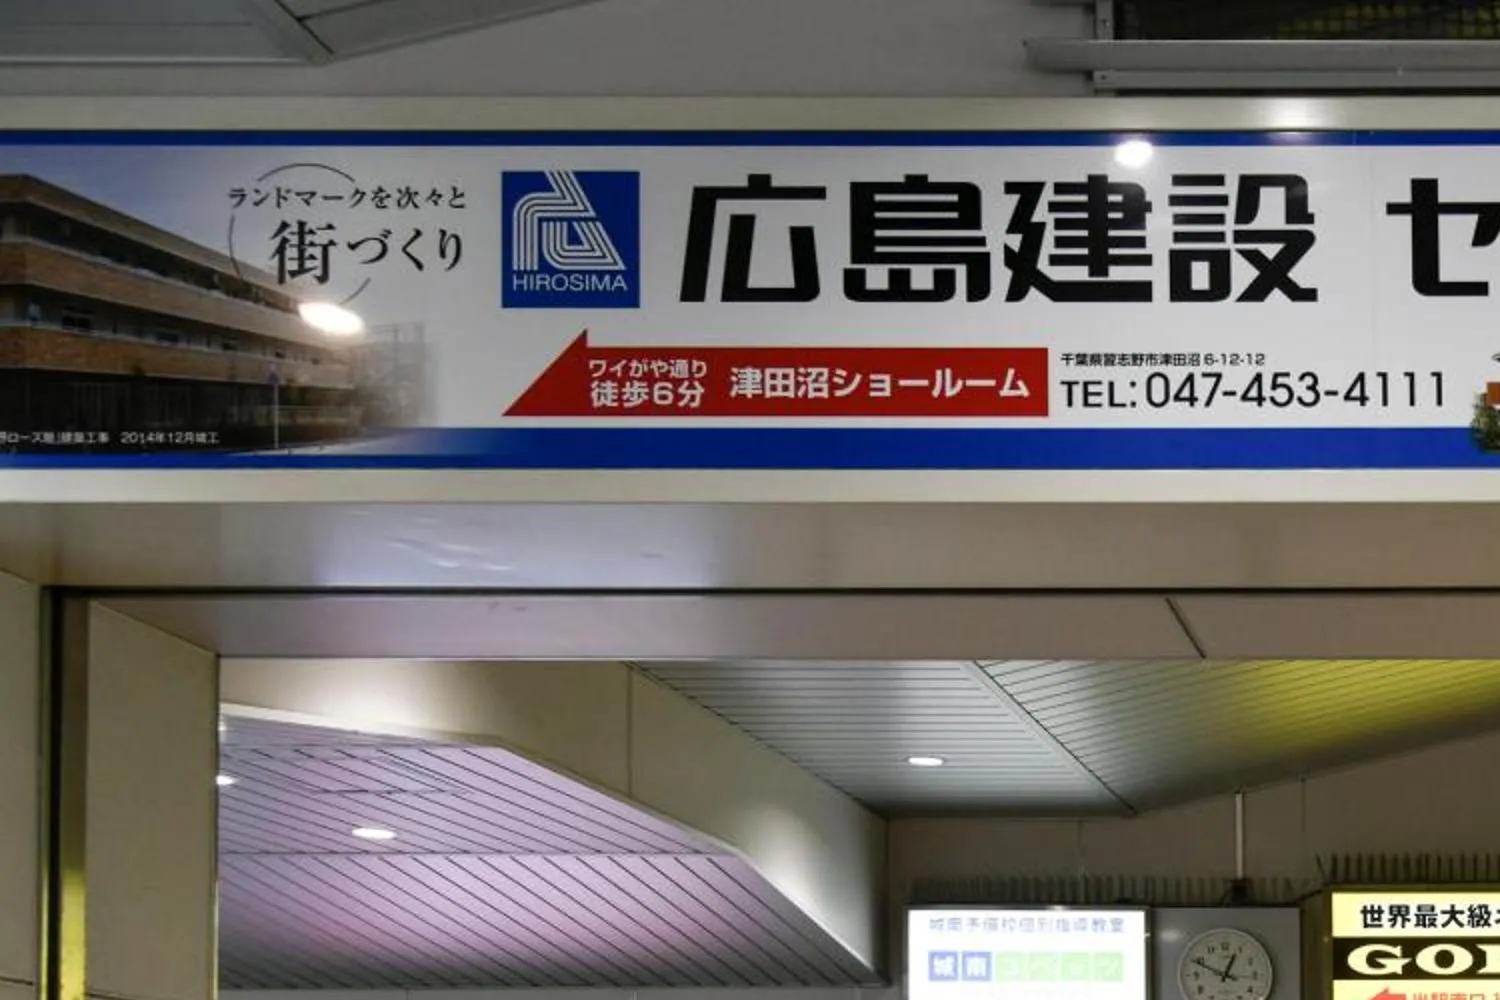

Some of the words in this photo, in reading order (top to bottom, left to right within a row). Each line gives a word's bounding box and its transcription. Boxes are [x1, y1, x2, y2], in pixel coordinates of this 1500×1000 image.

[228, 186, 467, 210] ランドマークを次々と
[270, 219, 464, 285] 街づくり
[679, 173, 1318, 303] 広島建設
[512, 273, 628, 292] HIROSIMA
[588, 359, 708, 379] ワイがや通り
[730, 367, 1030, 399] 津田沼ショールーム
[589, 381, 706, 408] 徒歩6分
[1060, 372, 1445, 408] TEL:047-453-4111
